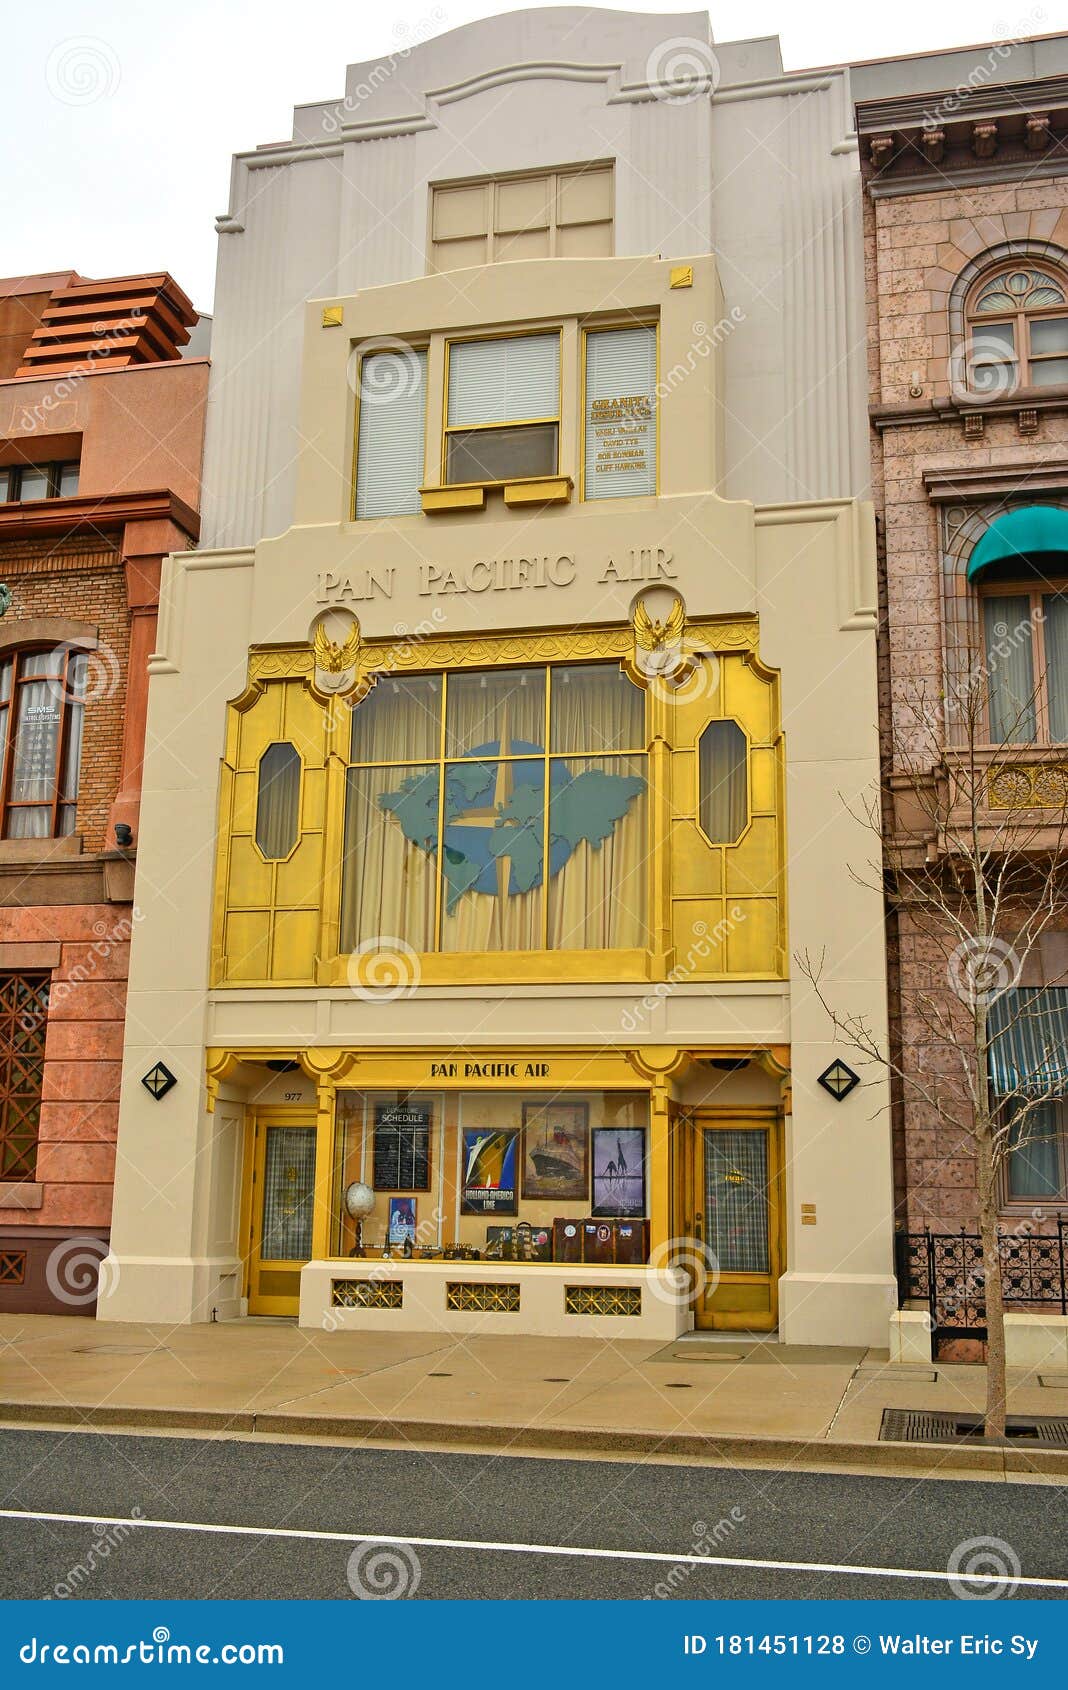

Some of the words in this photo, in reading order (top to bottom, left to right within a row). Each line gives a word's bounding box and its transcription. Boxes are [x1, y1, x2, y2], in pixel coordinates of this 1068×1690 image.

[316, 568, 395, 603] PAN
[419, 552, 577, 596] PACIFIC
[597, 548, 678, 583] AIR
[27, 706, 55, 714] SMS
[431, 1063, 458, 1077] PAN
[464, 1063, 519, 1077] PACIFIC
[524, 1063, 551, 1077] AIR
[284, 1092, 302, 1101] 977
[382, 1114, 424, 1122] SCHEDULE
[483, 1199, 496, 1210] LINE
